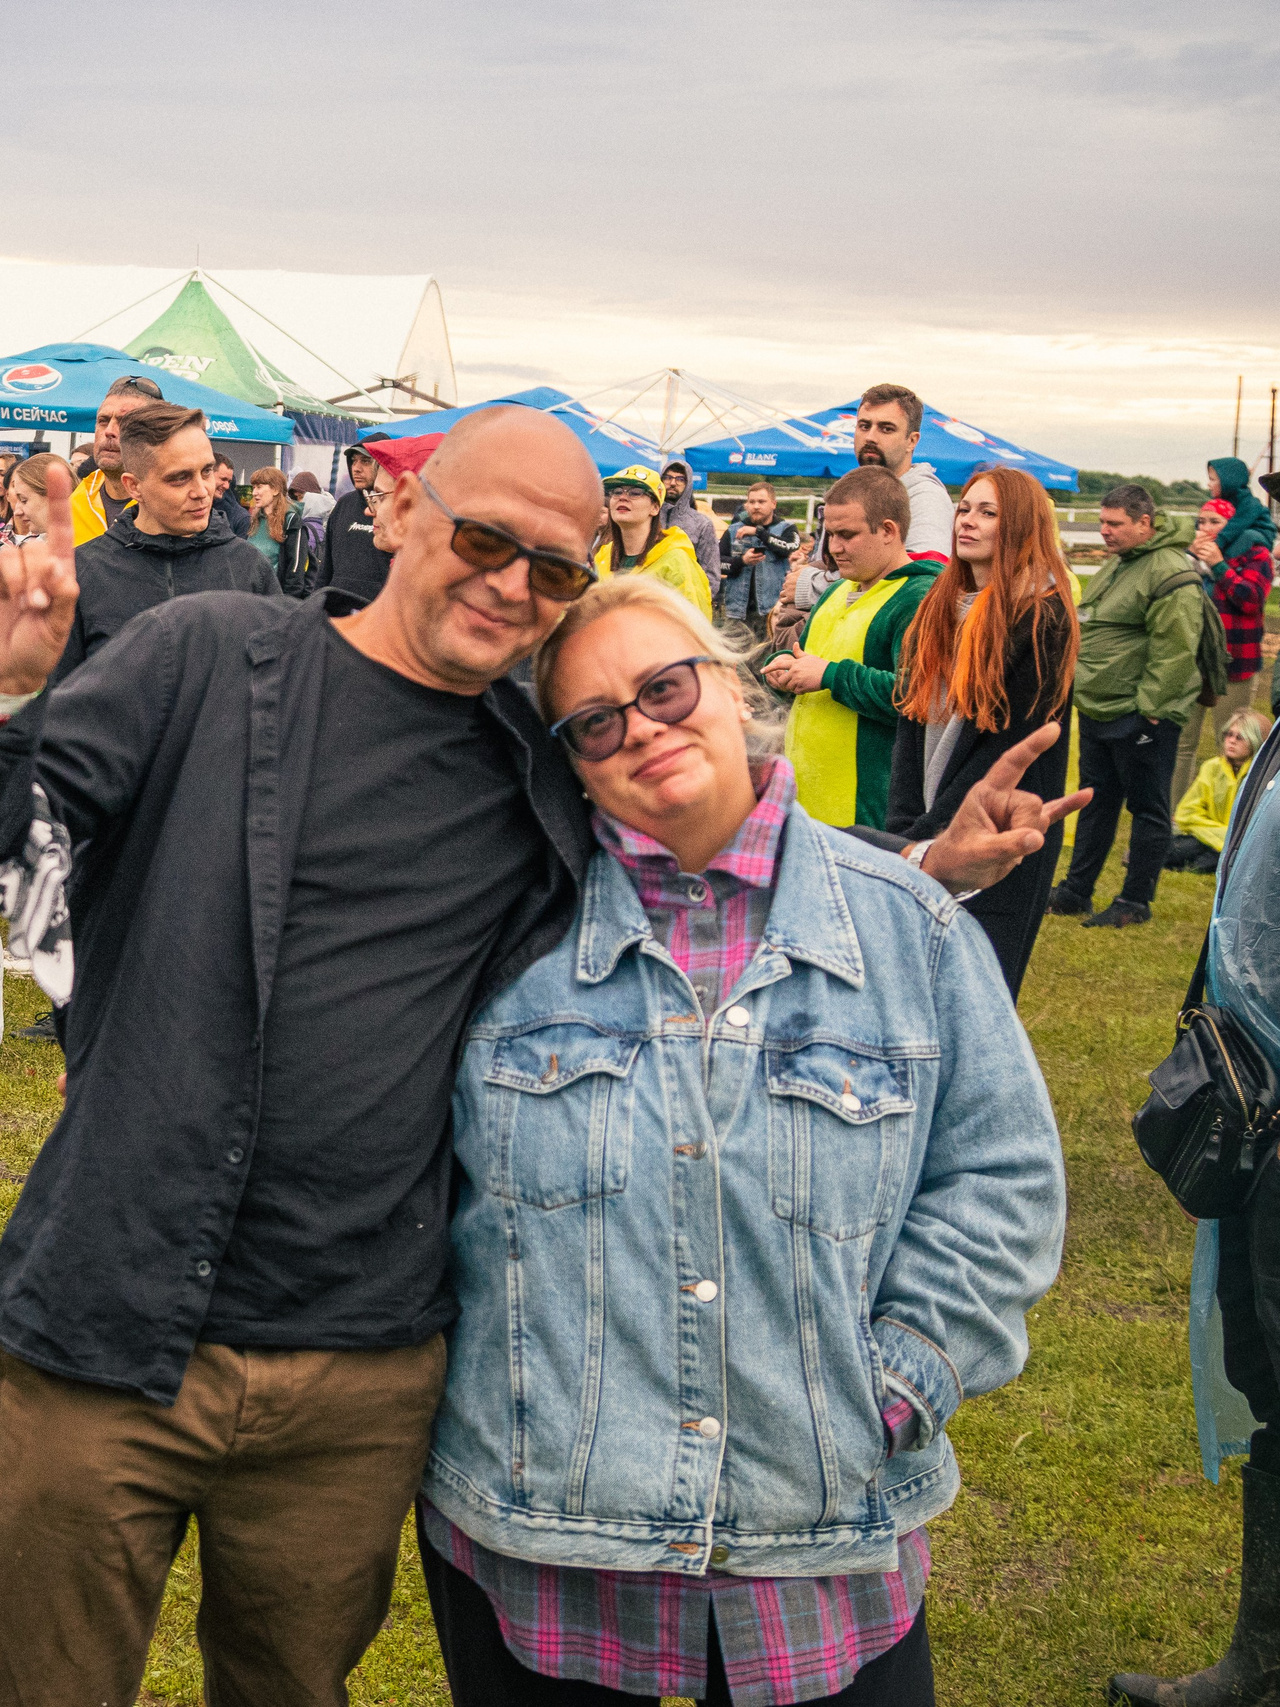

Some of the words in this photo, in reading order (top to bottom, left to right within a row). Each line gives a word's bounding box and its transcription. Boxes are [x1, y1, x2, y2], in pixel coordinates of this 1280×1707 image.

[1, 407, 10, 420] И
[13, 406, 68, 423] СЕЙЧАС
[212, 419, 240, 434] pepsi
[746, 453, 778, 461] BLANC
